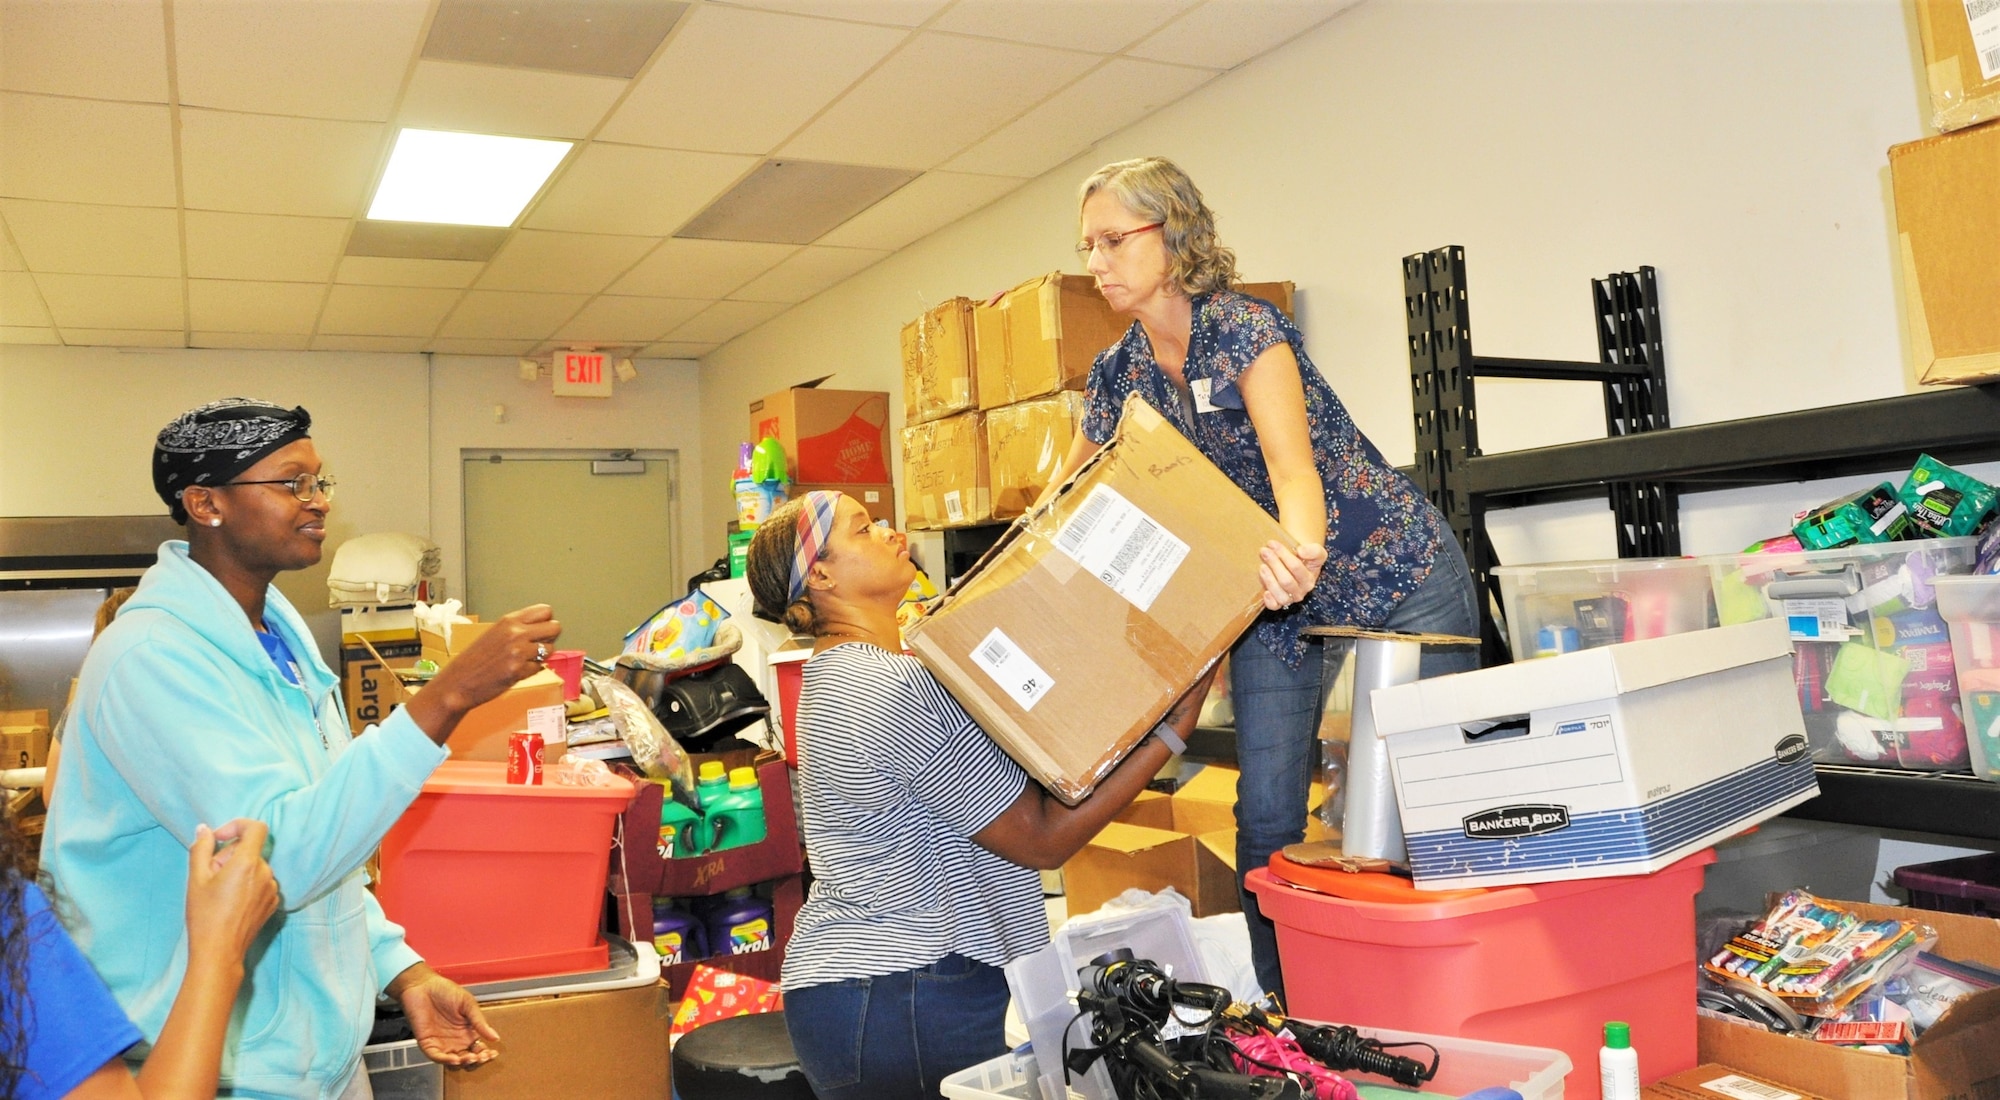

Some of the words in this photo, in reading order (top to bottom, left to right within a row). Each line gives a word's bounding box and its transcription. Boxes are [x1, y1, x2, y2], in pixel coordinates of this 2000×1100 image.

[566, 355, 603, 383] EXIT
[841, 441, 873, 459] HOME
[1912, 502, 1930, 519] Thin
[1899, 624, 1940, 638] TAMPAX
[1022, 678, 1037, 694] 46
[1919, 679, 1952, 692] Playtex
[1777, 744, 1797, 759] BANKERS
[1469, 815, 1529, 832] BANKERS
[1530, 812, 1563, 826] BOX
[1742, 933, 1781, 948] REACH
